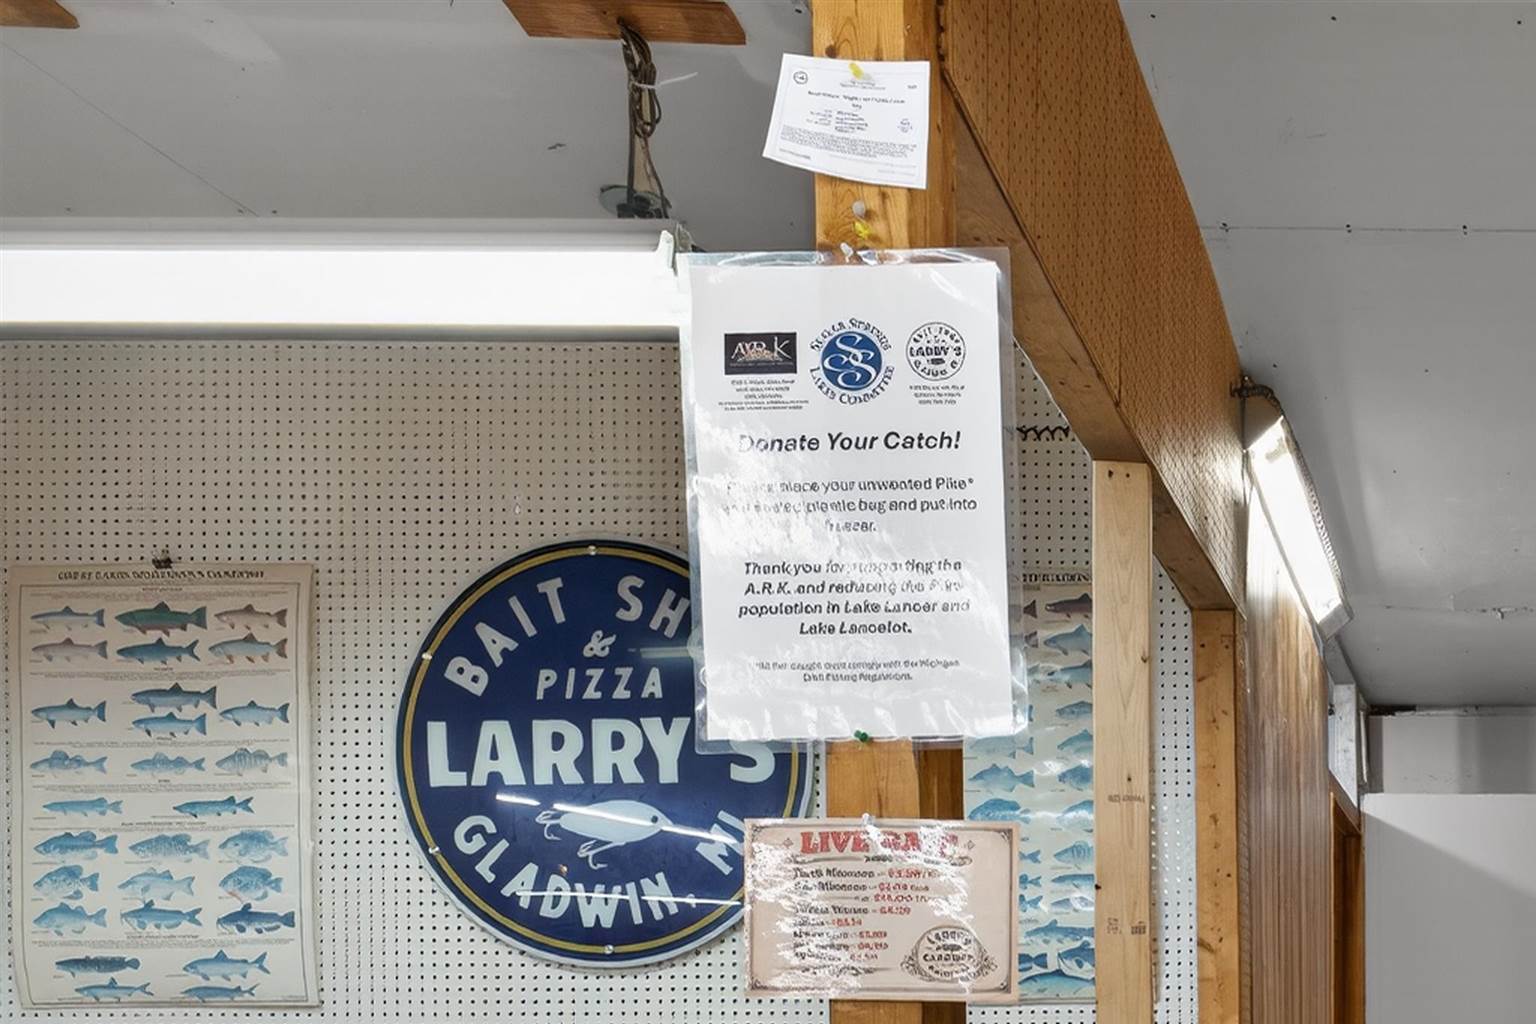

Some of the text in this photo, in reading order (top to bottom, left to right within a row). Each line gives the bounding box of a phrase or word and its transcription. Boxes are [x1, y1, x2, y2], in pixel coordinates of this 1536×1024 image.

[827, 431, 879, 452] Your
[883, 430, 962, 451] Catch!
[823, 480, 856, 495] your
[744, 561, 791, 575] Thank
[792, 562, 822, 577] you
[796, 581, 826, 594] and
[738, 601, 823, 618] population
[844, 601, 881, 614] Lake
[444, 575, 691, 697] BAIT SH
[799, 621, 836, 635] Lake
[583, 629, 617, 658] &
[536, 666, 664, 700] PIZZA
[427, 716, 776, 787] LARRYS
[801, 830, 870, 854] LIVE
